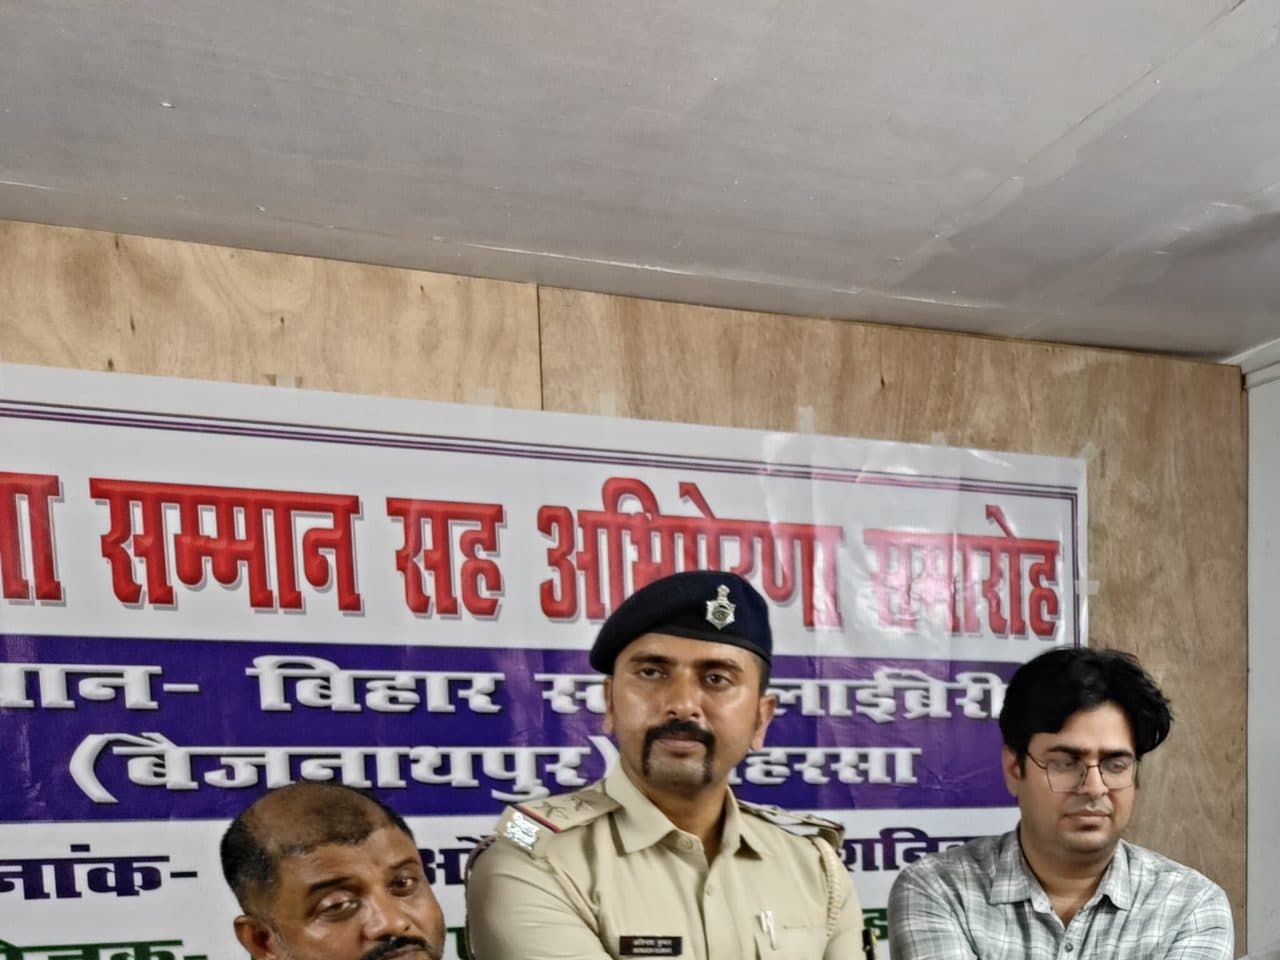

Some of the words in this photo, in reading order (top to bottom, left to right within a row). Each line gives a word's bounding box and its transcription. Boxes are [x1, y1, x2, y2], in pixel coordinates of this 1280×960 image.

[89, 476, 362, 613] सम्मान
[386, 495, 503, 617] सह
[863, 504, 1061, 637] समारोह
[245, 655, 505, 713] बिहार
[729, 746, 922, 785] हरसा
